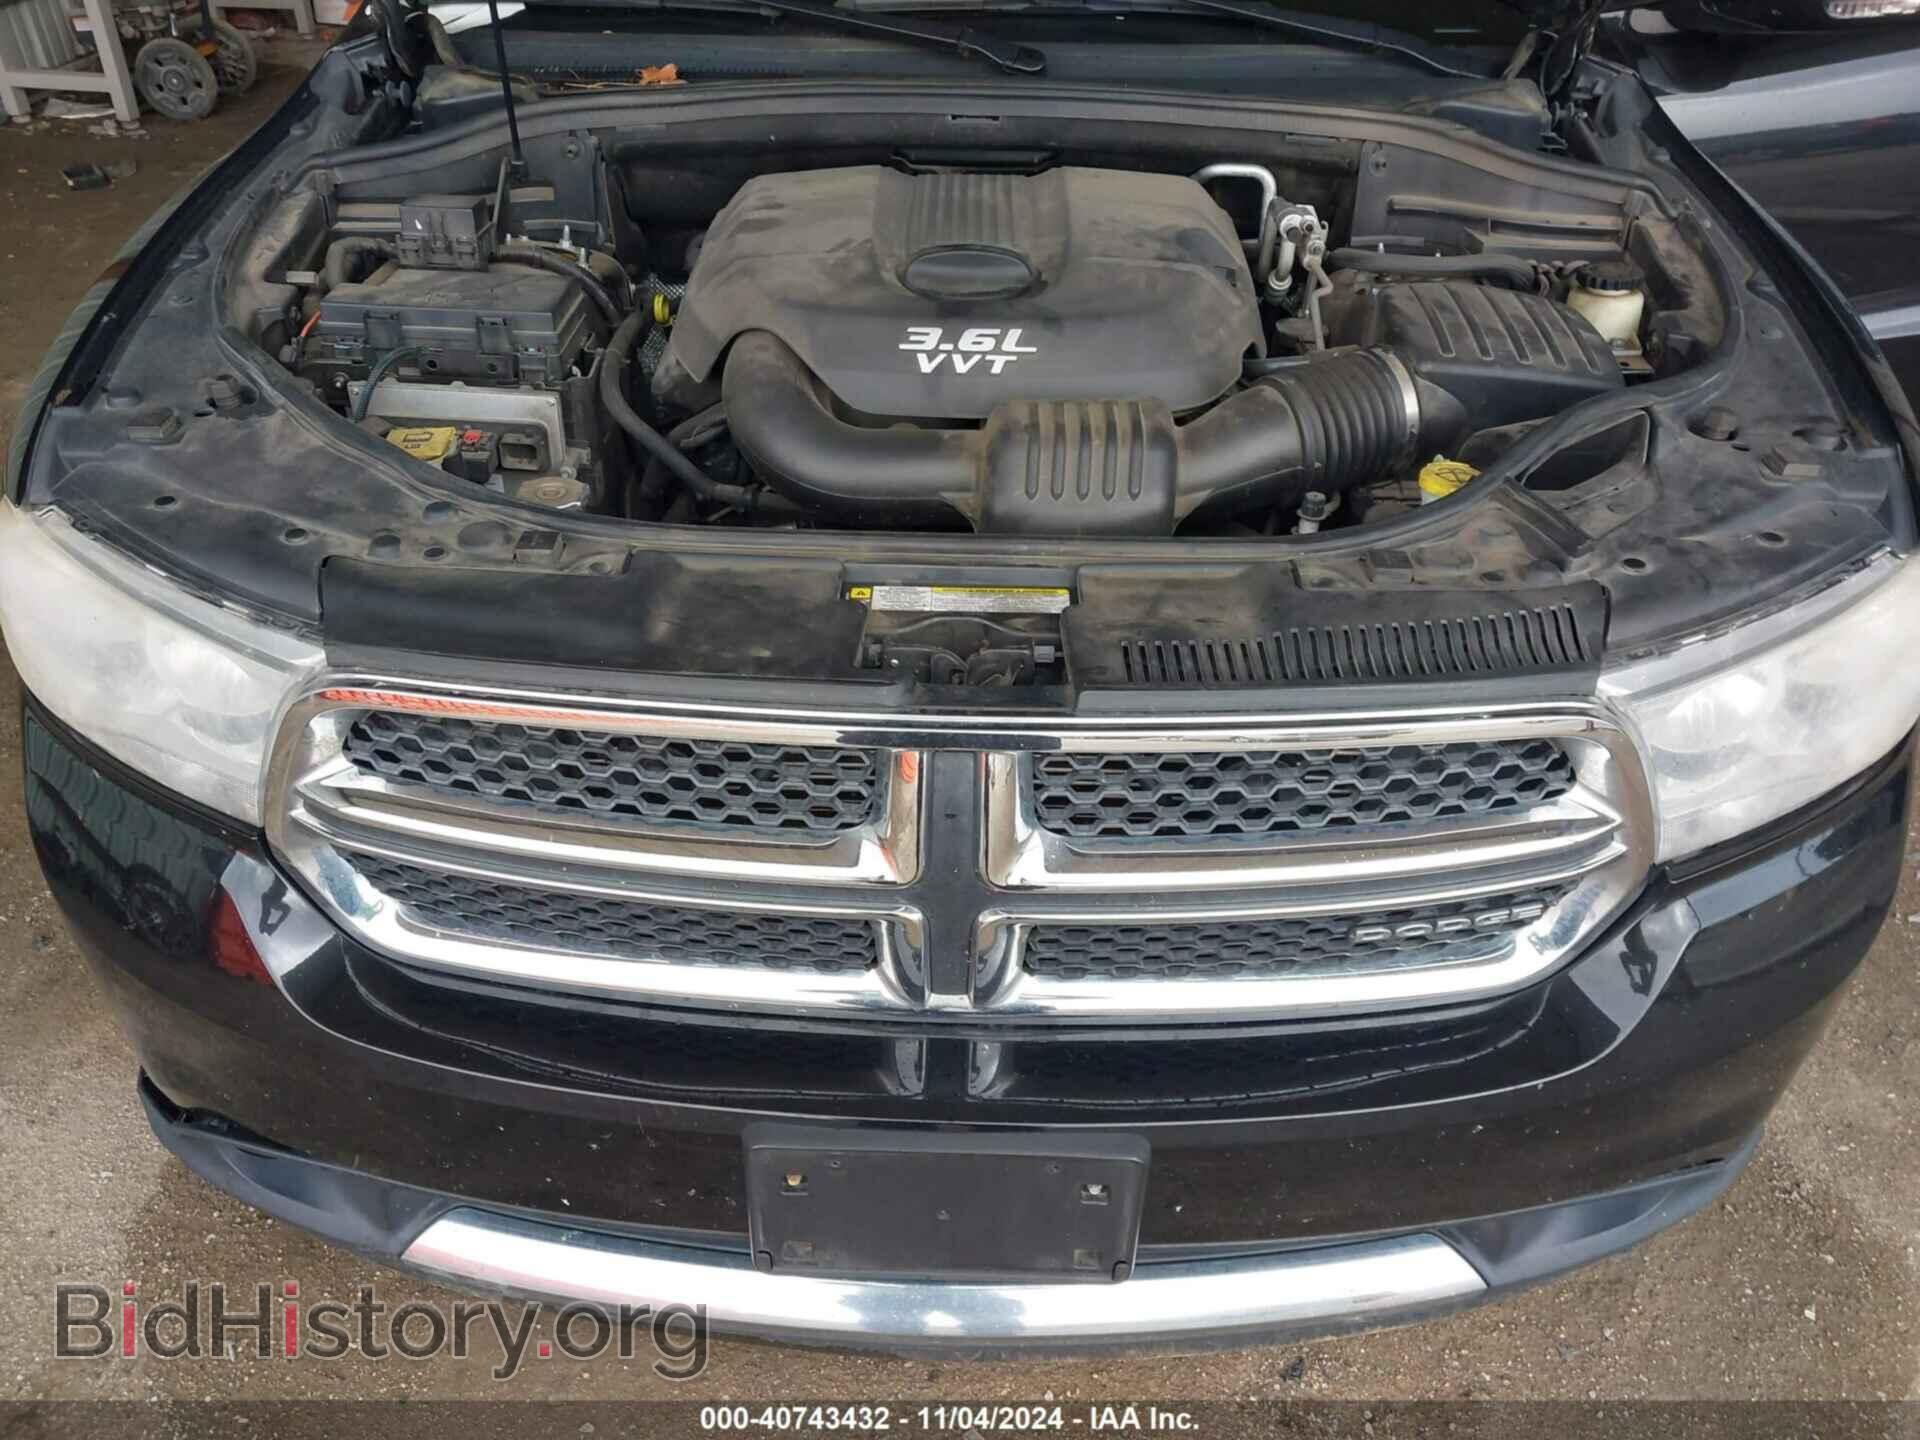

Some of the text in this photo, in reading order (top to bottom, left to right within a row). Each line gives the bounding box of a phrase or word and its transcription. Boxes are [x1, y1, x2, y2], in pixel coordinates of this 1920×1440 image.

[899, 327, 1037, 352] 3.6L
[916, 353, 1018, 374] VVT
[1354, 904, 1545, 942] DODGE
